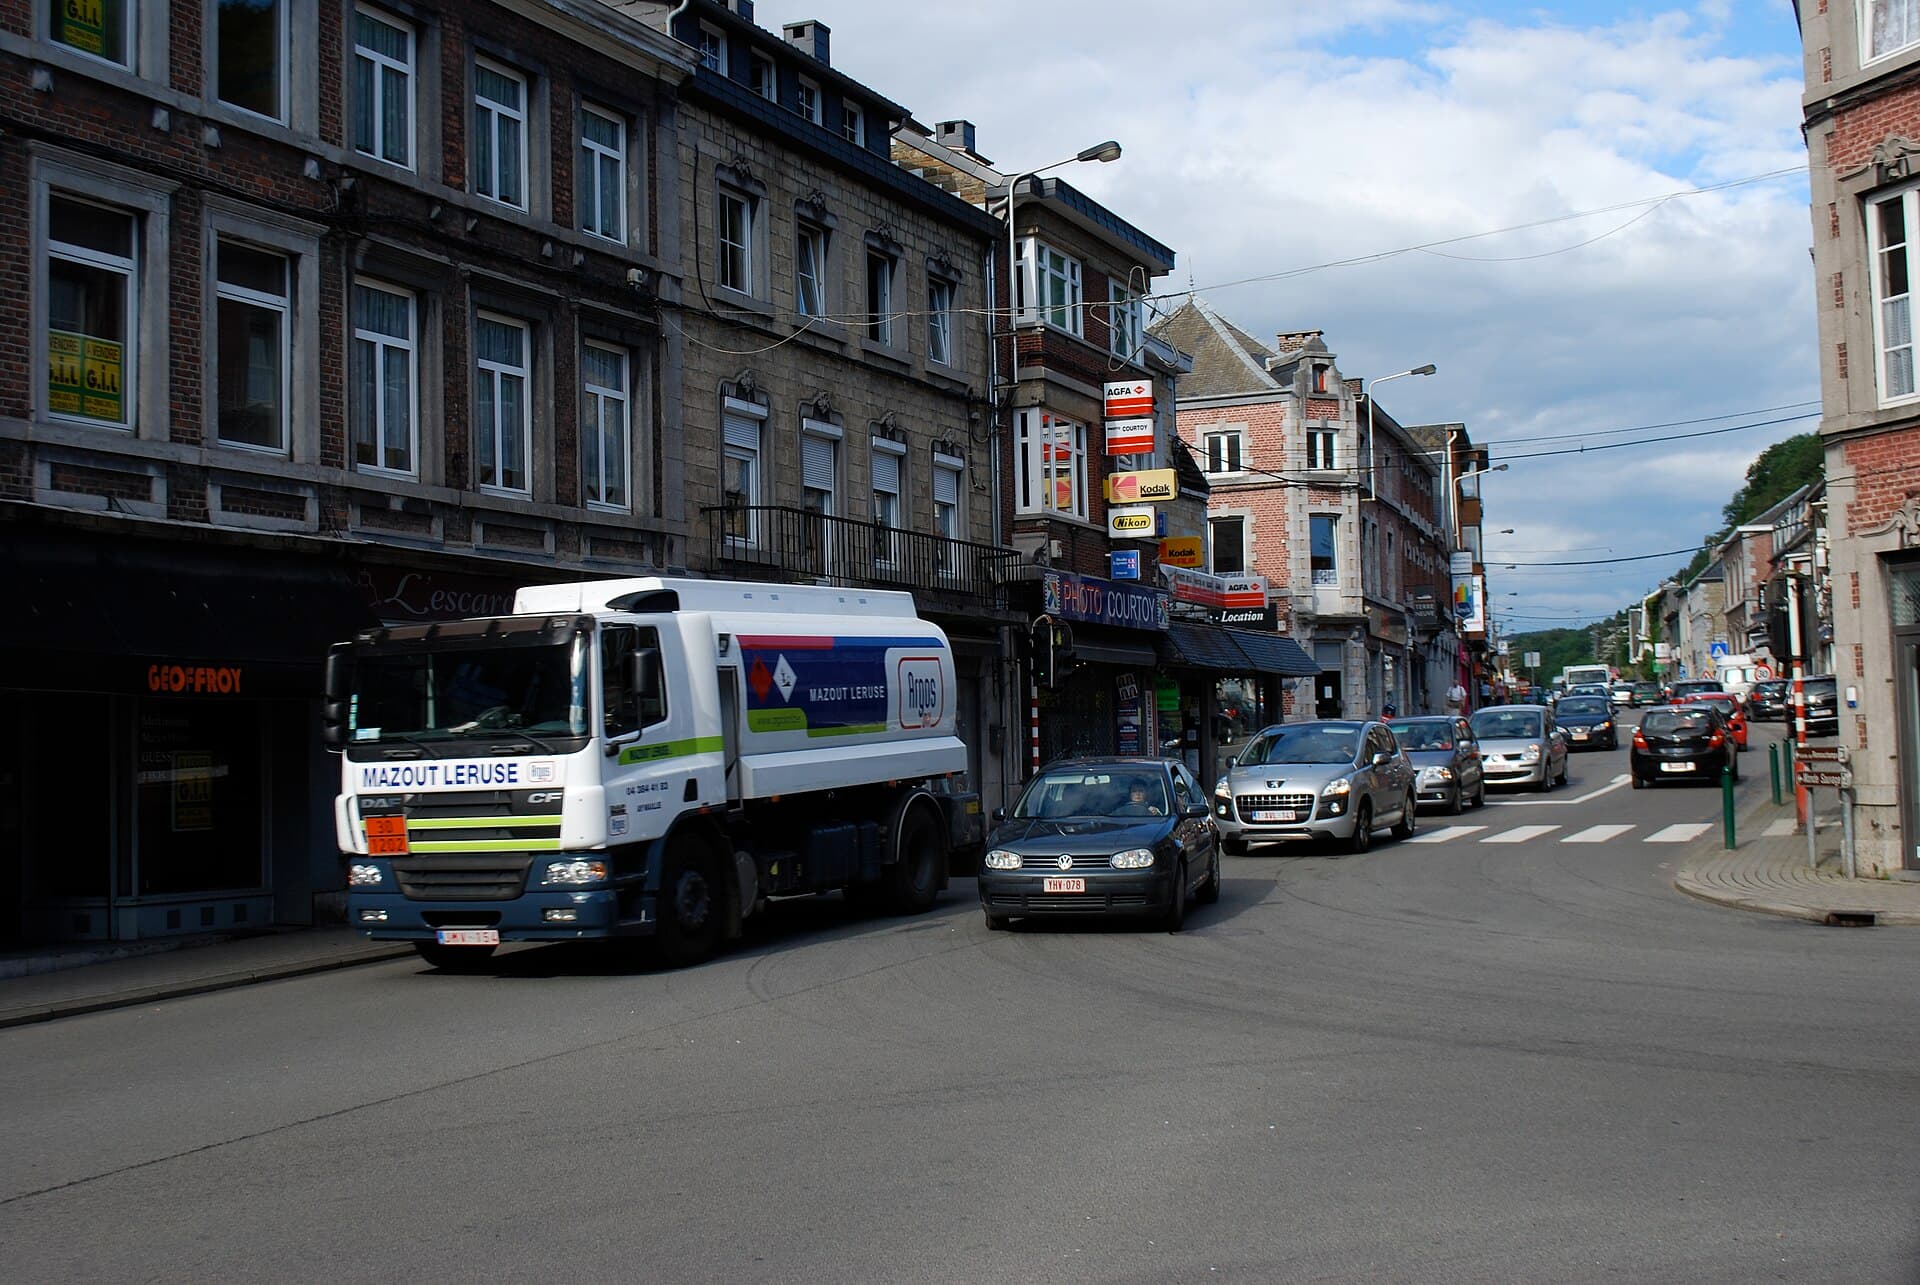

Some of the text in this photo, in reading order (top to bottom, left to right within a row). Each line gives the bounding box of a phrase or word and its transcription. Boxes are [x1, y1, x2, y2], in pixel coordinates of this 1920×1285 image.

[1107, 387, 1131, 396] AGFA
[1122, 424, 1148, 433] COURTOY
[1140, 483, 1170, 494] Kodak
[1116, 517, 1147, 528] Nikon
[1168, 548, 1195, 557] Kodak
[1228, 583, 1248, 591] AGFA
[1063, 581, 1155, 628] PHOTO COURTOY
[1221, 611, 1264, 623] Location
[148, 663, 241, 695] GEOFFROY
[809, 686, 885, 701] MAZOUT LERUSE
[908, 672, 936, 717] Argos
[363, 763, 518, 788] MAZOUT LERUSE
[361, 797, 402, 809] DAF
[527, 792, 562, 804] CF
[376, 820, 392, 834] 30
